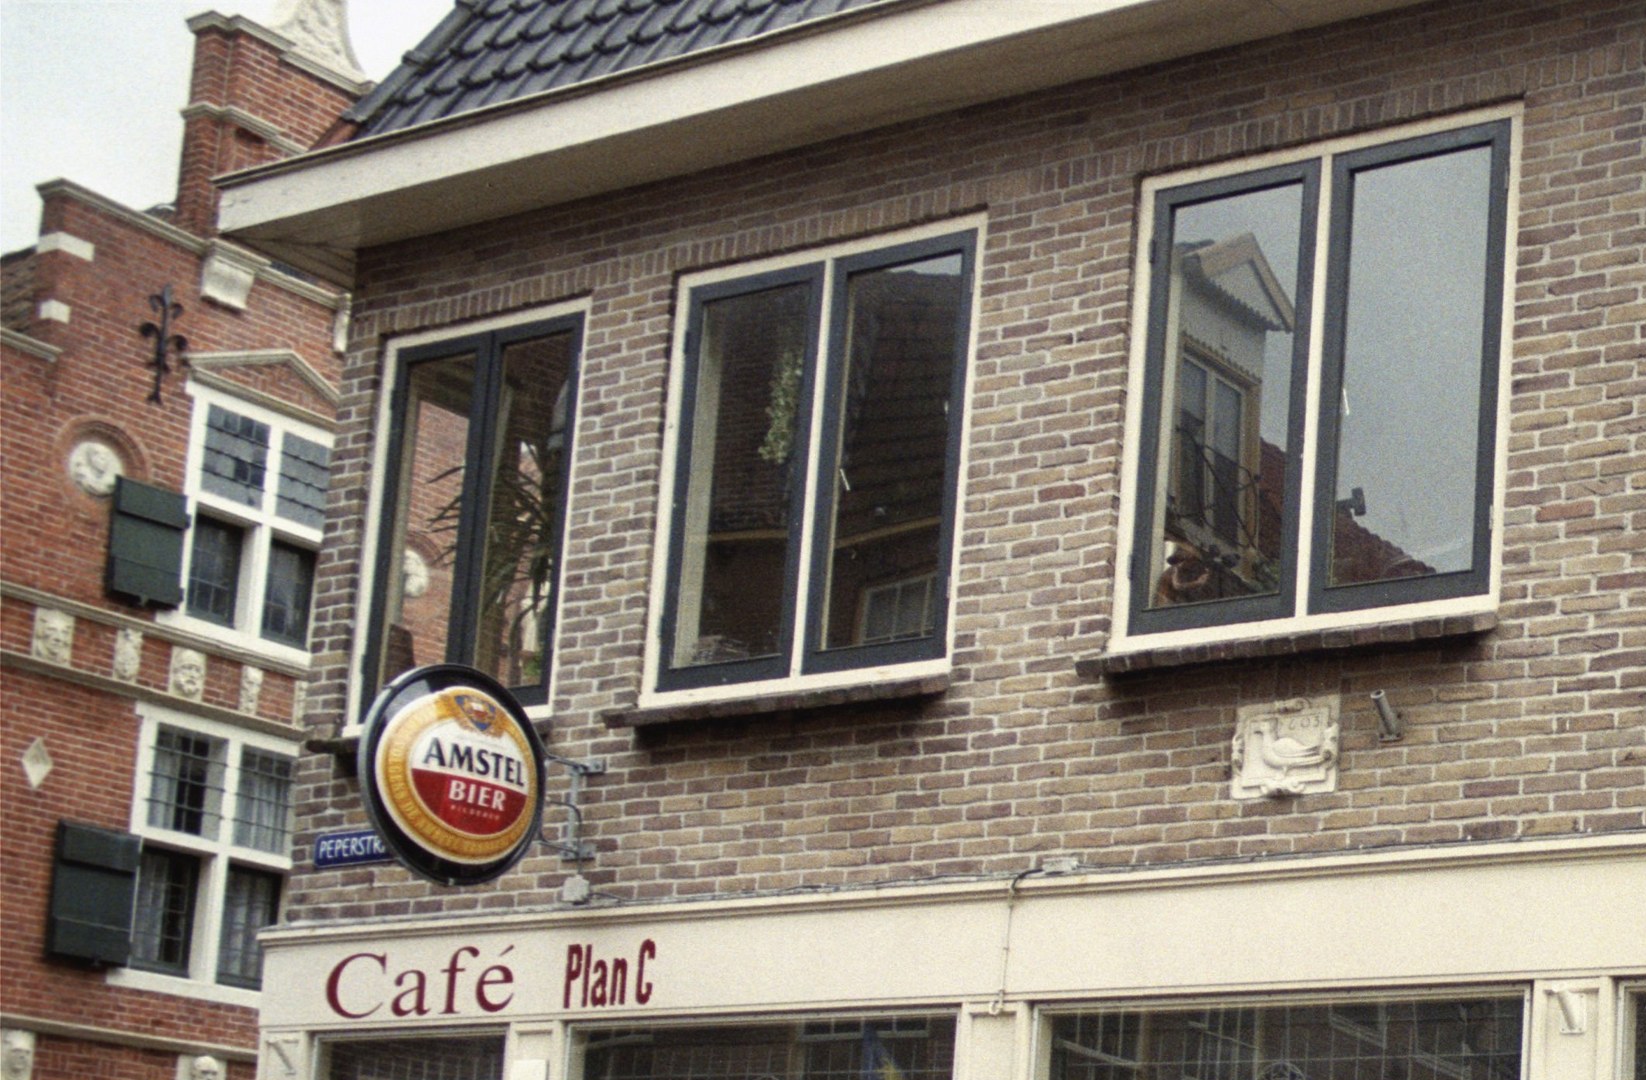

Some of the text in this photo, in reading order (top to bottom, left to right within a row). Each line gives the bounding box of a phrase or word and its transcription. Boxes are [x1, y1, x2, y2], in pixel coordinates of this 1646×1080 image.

[422, 736, 525, 788] AMSTEL
[448, 779, 508, 812] BIER
[319, 834, 386, 860] PEPERSTR
[325, 939, 656, 1020] Café Plan C
